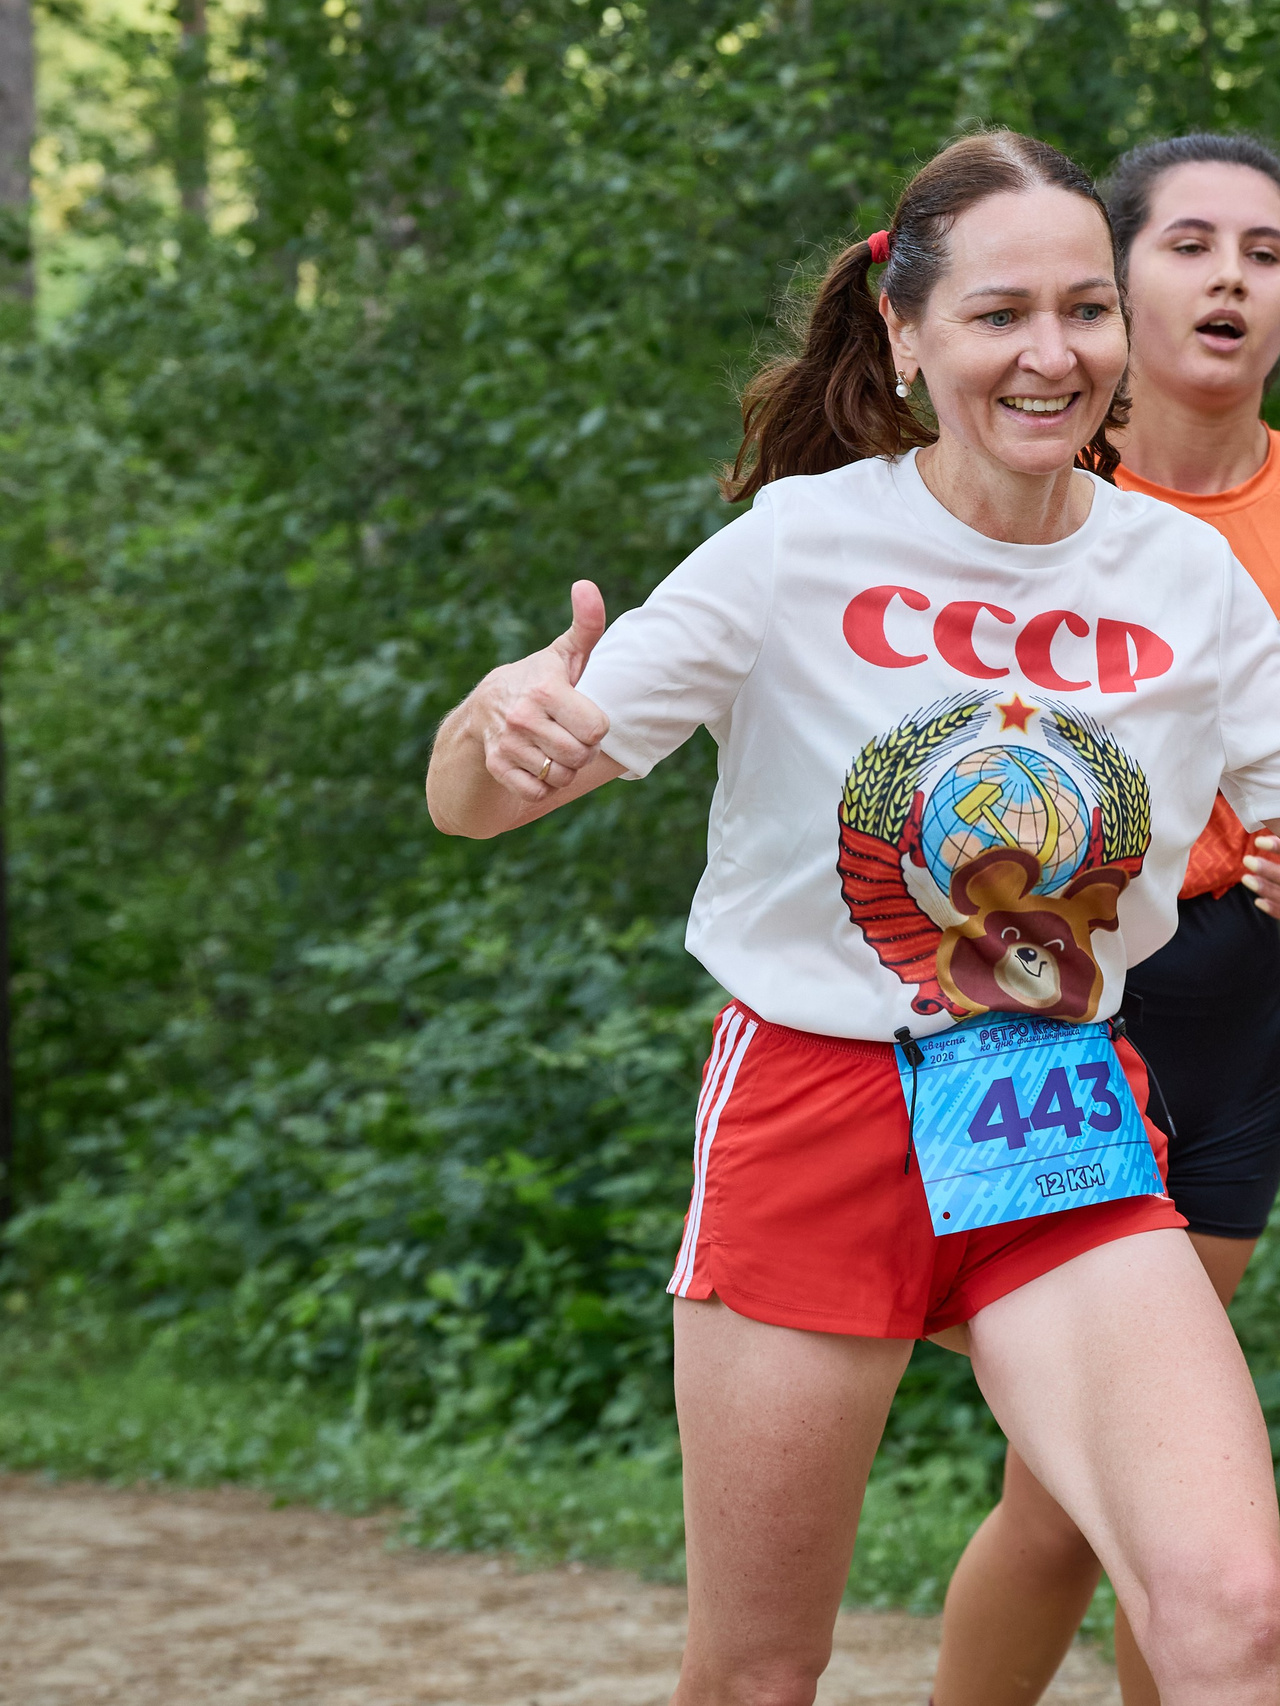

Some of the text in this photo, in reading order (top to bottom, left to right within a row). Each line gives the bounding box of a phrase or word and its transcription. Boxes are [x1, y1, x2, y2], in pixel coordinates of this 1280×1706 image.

[843, 585, 1173, 693] СССР
[921, 1035, 967, 1051] августа
[980, 1023, 1028, 1045] РЕТРО
[930, 1051, 954, 1064] 2026
[967, 1061, 1122, 1150] 443
[1035, 1170, 1065, 1197] 12
